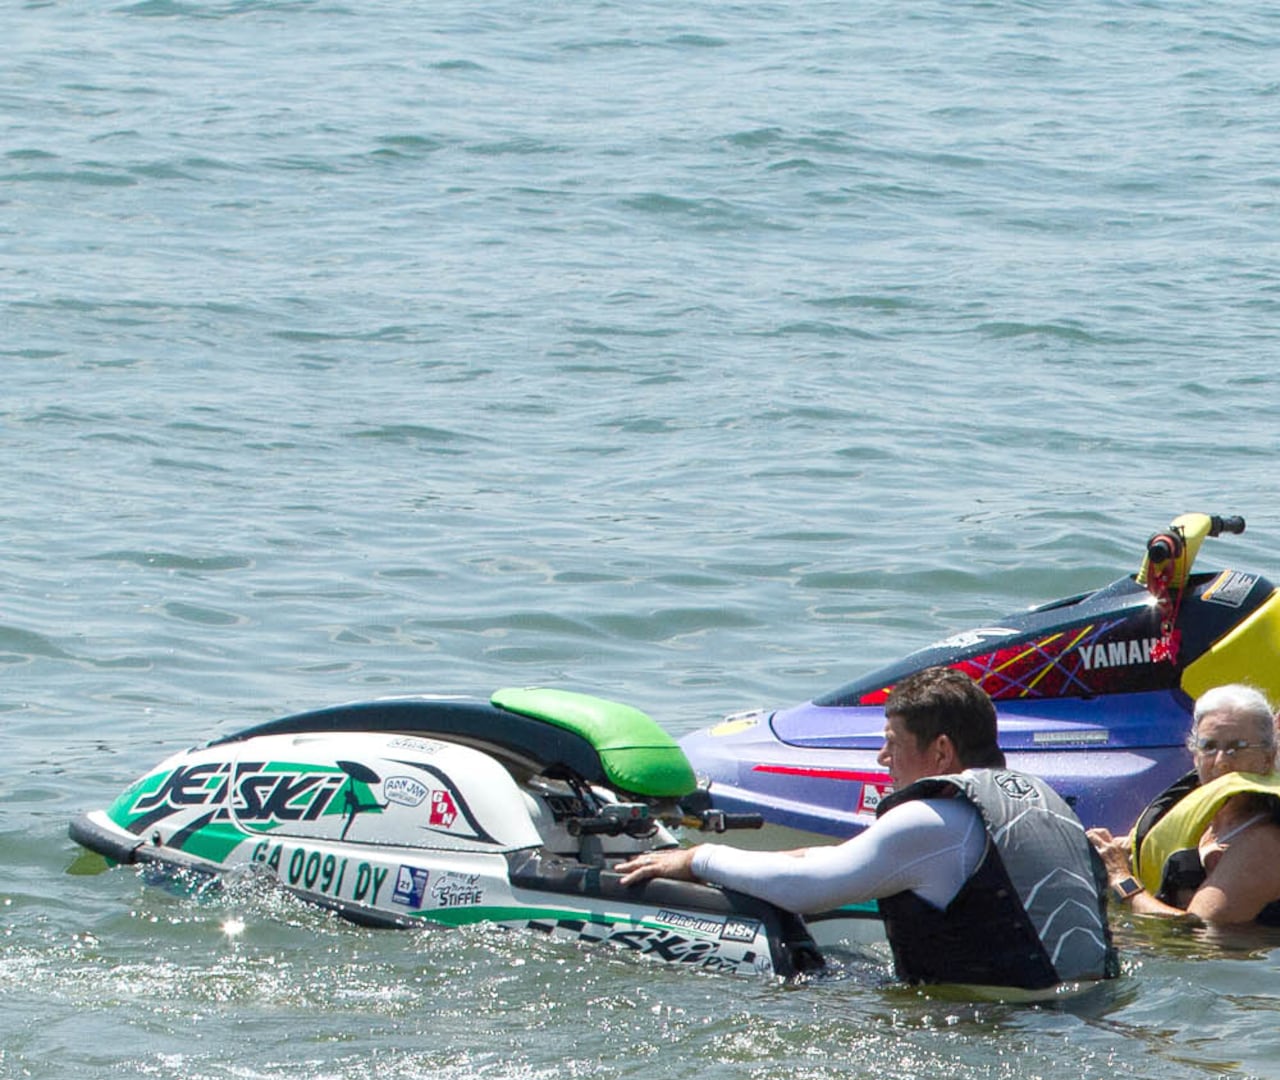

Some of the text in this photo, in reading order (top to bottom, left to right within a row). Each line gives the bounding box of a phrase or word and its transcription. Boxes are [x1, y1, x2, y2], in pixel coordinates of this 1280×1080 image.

[1078, 637, 1172, 670] YAMAH
[864, 796, 878, 805] 20
[288, 847, 348, 897] 0091
[354, 861, 388, 905] DY
[400, 880, 411, 890] 21
[723, 923, 755, 938] WSM
